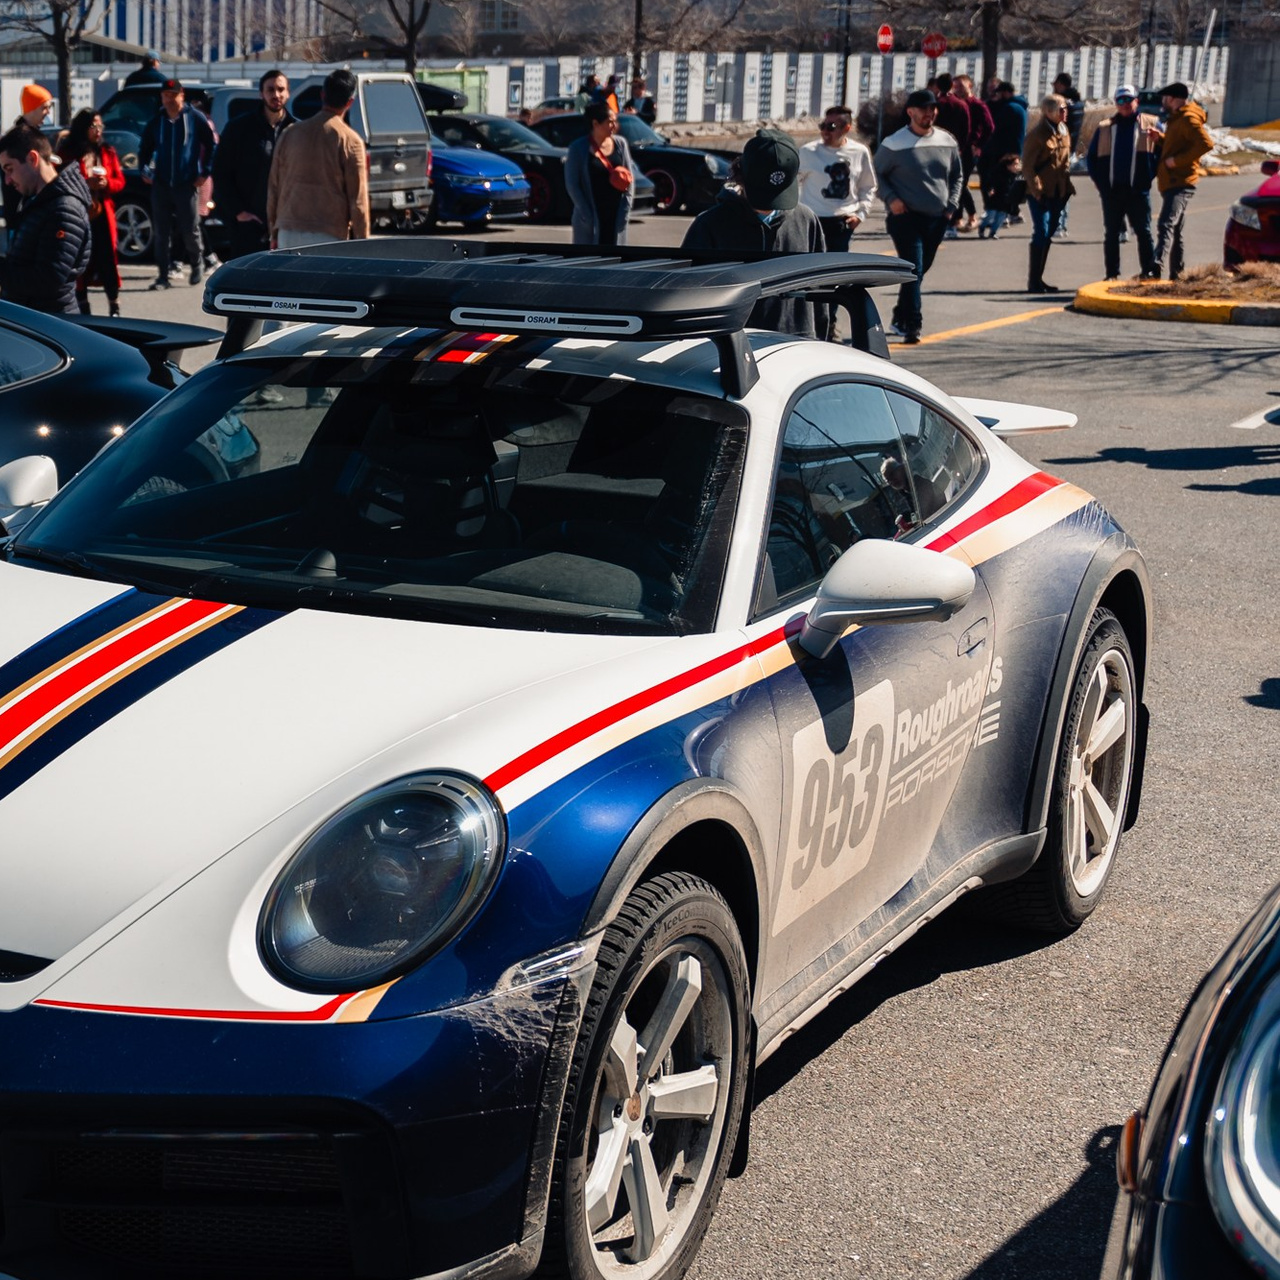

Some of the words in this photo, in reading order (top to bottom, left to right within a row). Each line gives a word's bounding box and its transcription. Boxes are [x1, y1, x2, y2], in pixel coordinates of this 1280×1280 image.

[273, 301, 298, 310] OSRAM
[527, 315, 556, 325] OSRAM
[893, 650, 1003, 765] Roughroads
[791, 723, 884, 890] 953
[883, 712, 1000, 819] PORSCHE
